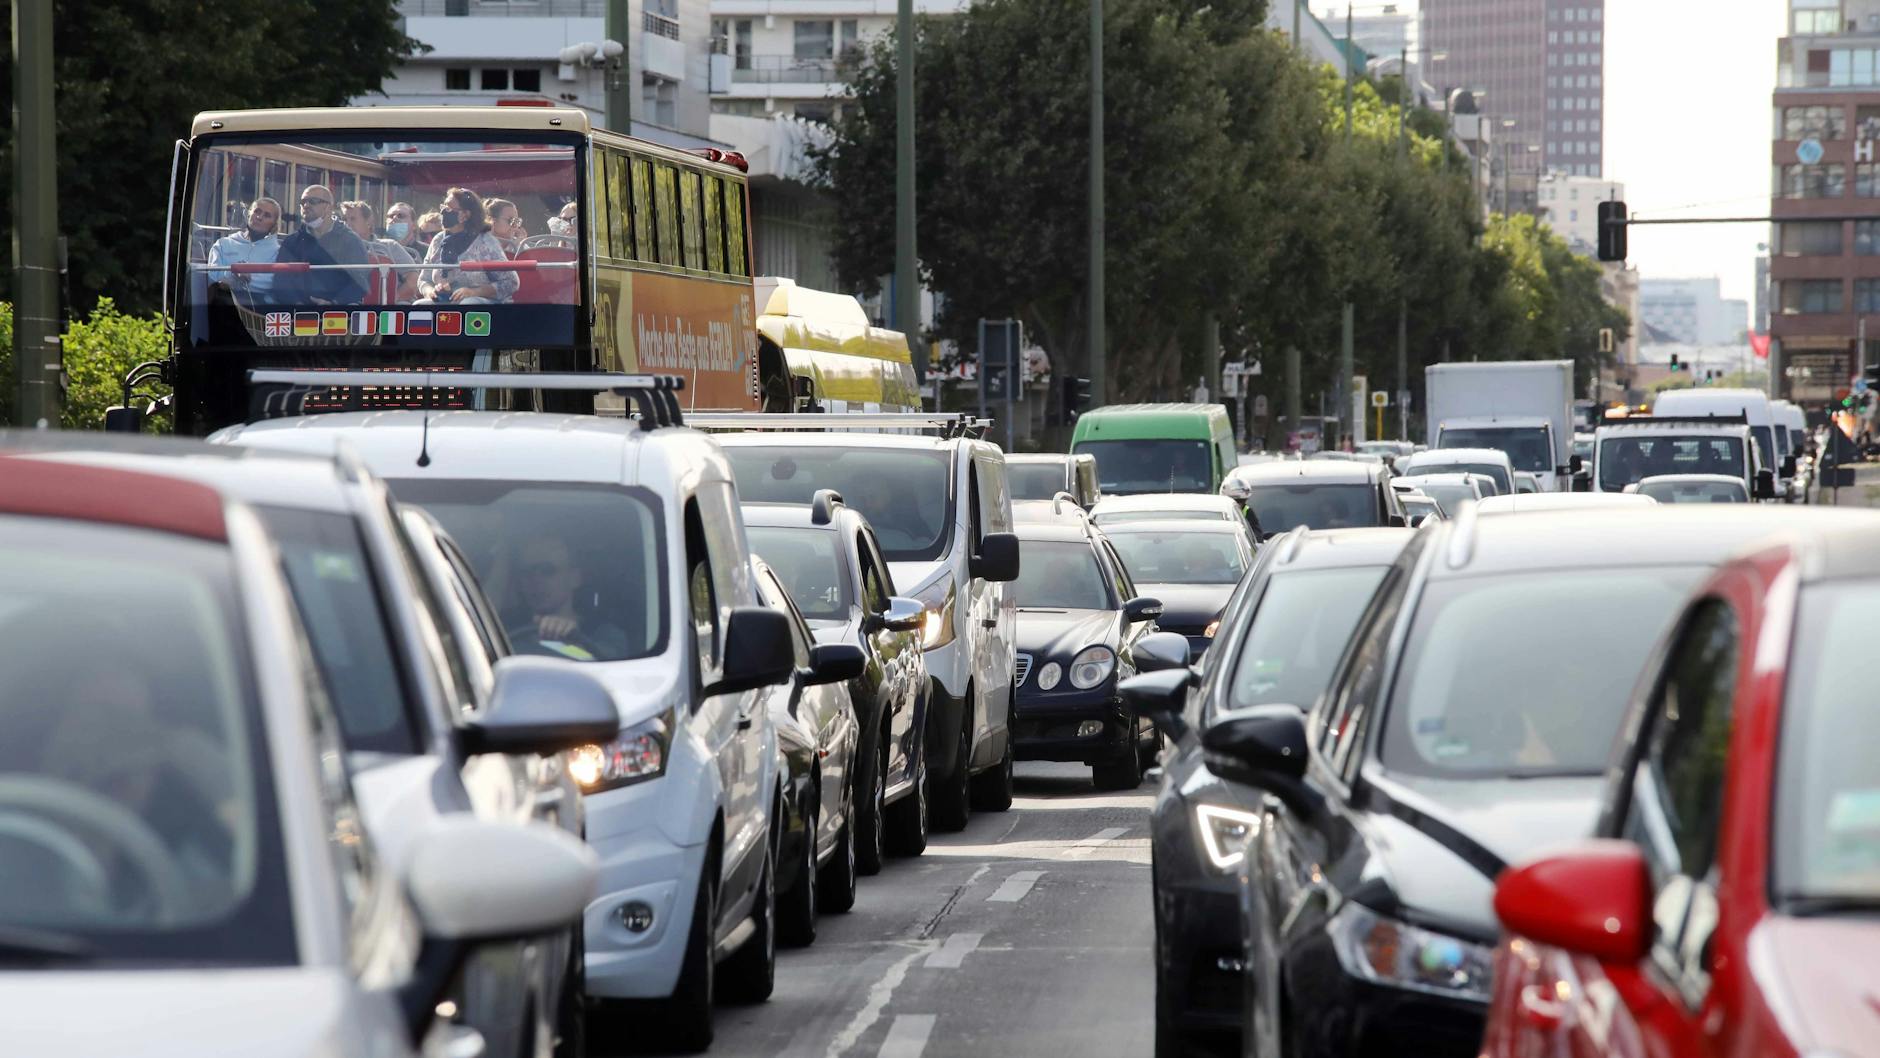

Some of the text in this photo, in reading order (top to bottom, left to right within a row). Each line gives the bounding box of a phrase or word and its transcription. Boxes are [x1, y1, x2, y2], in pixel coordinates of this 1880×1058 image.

[1854, 140, 1873, 162] H
[664, 315, 677, 369] das
[677, 316, 696, 370] Beste
[697, 335, 709, 371] aus
[709, 320, 734, 372] BERLIN
